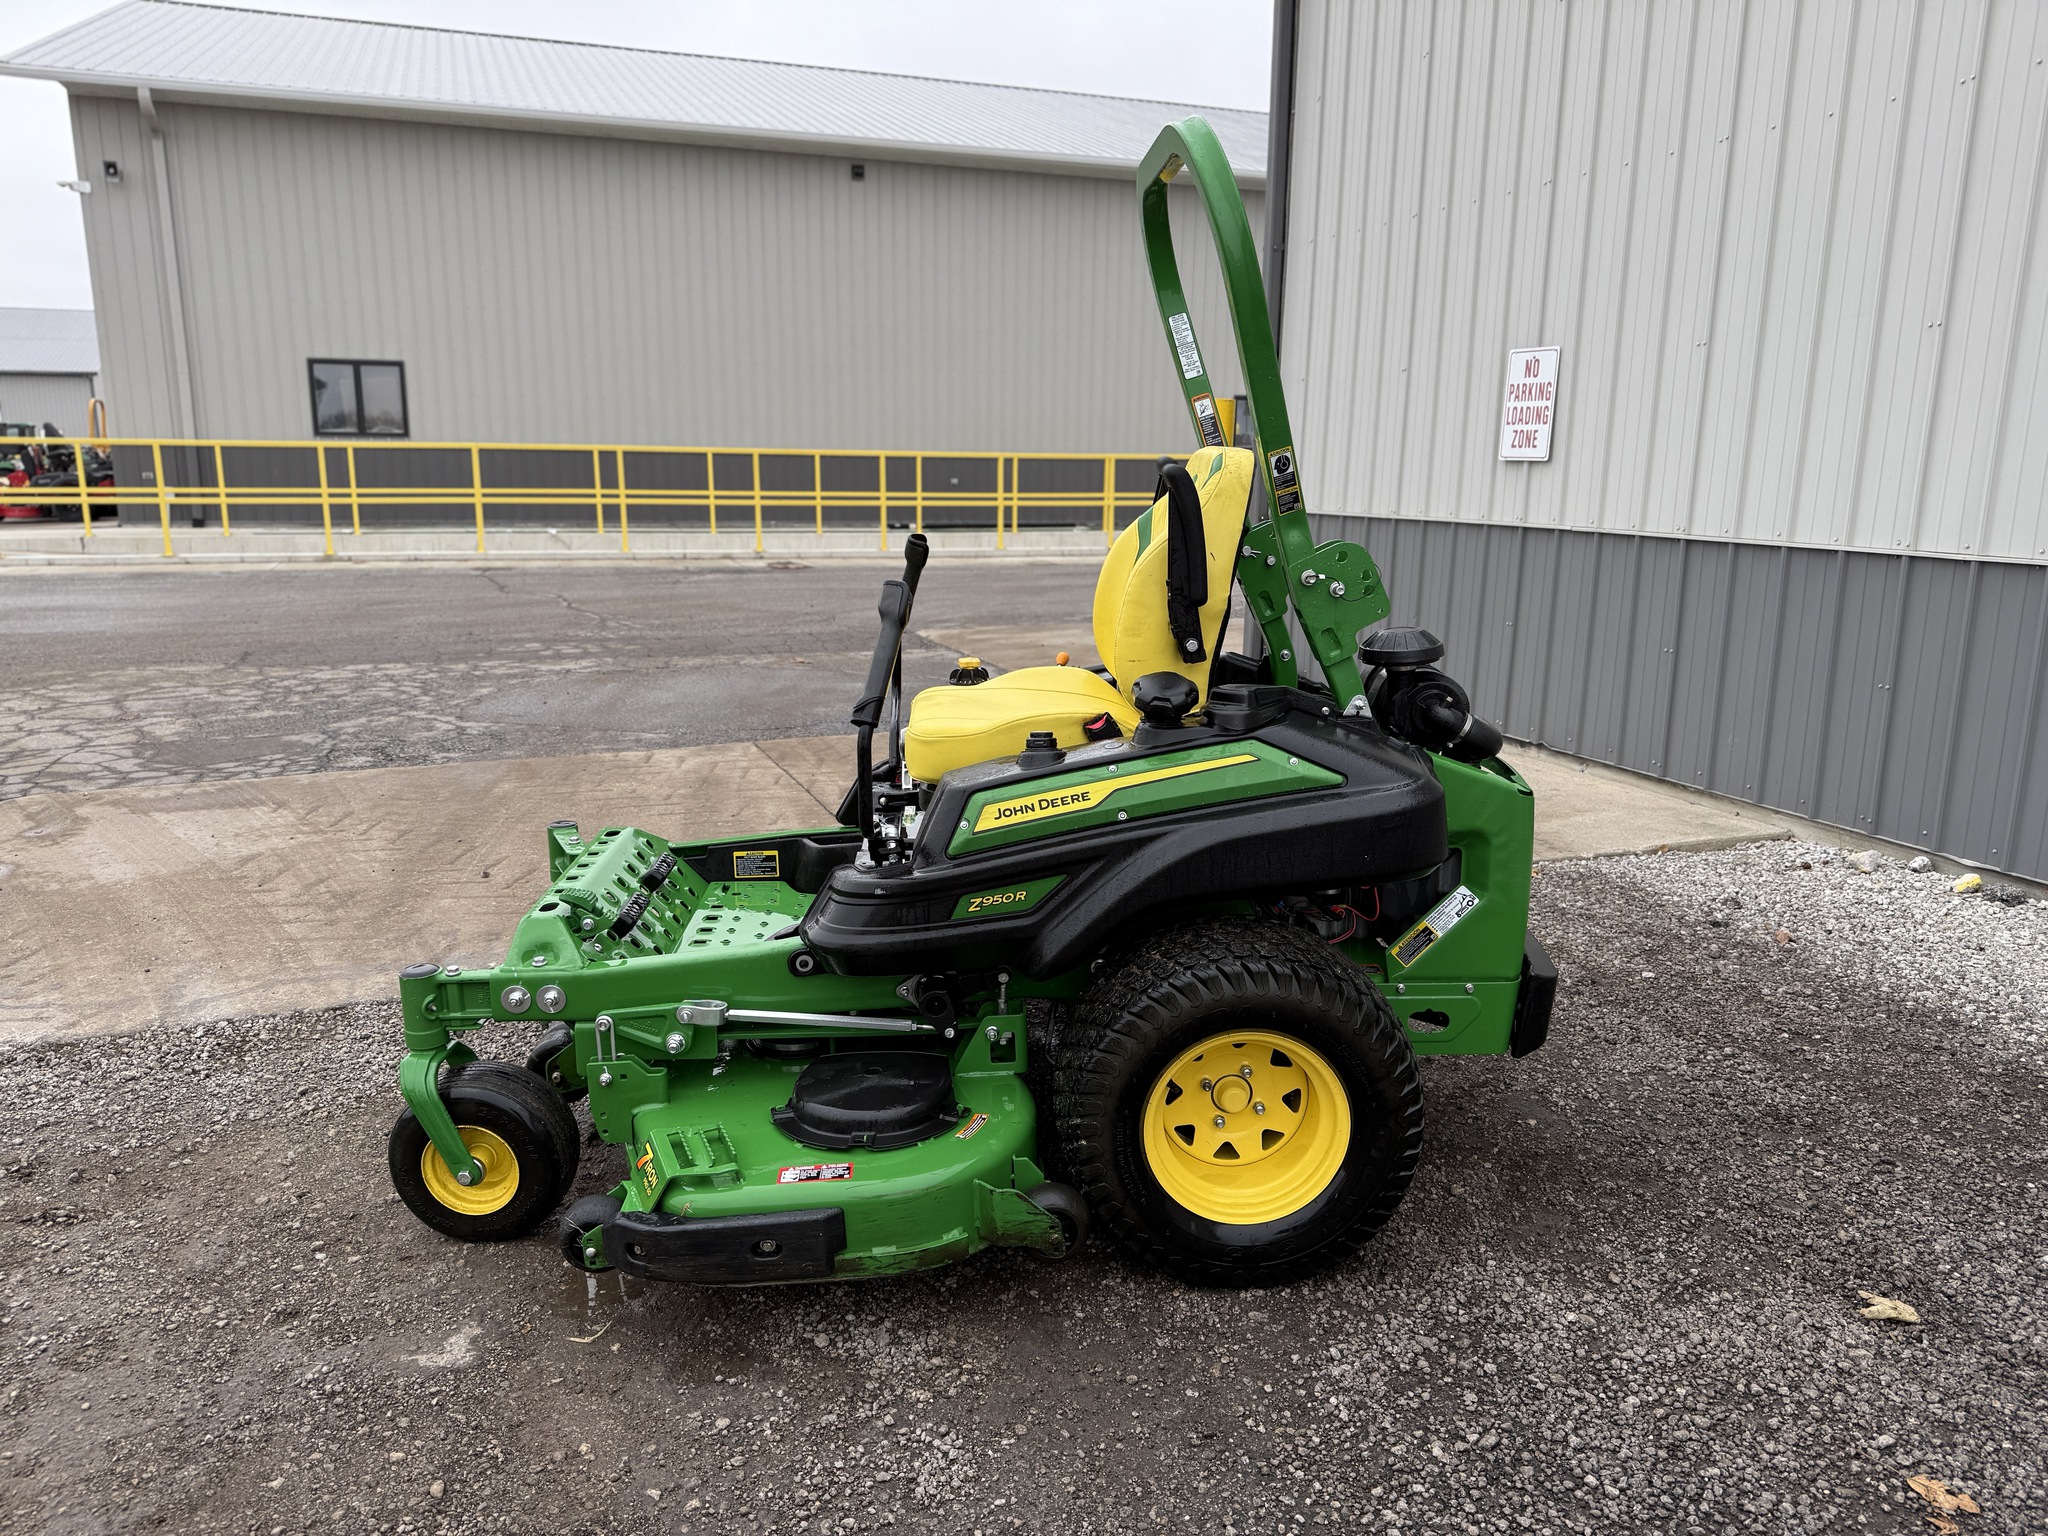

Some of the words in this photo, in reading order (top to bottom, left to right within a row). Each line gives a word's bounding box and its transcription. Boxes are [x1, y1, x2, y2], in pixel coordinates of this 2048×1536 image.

[1524, 358, 1540, 378] NO
[1508, 381, 1552, 402] PARKING
[1506, 405, 1549, 425] LOADING
[1511, 429, 1538, 448] ZONE
[994, 803, 1036, 820] JOHN
[1038, 791, 1091, 811] DEERE
[967, 891, 1027, 912] Z950R
